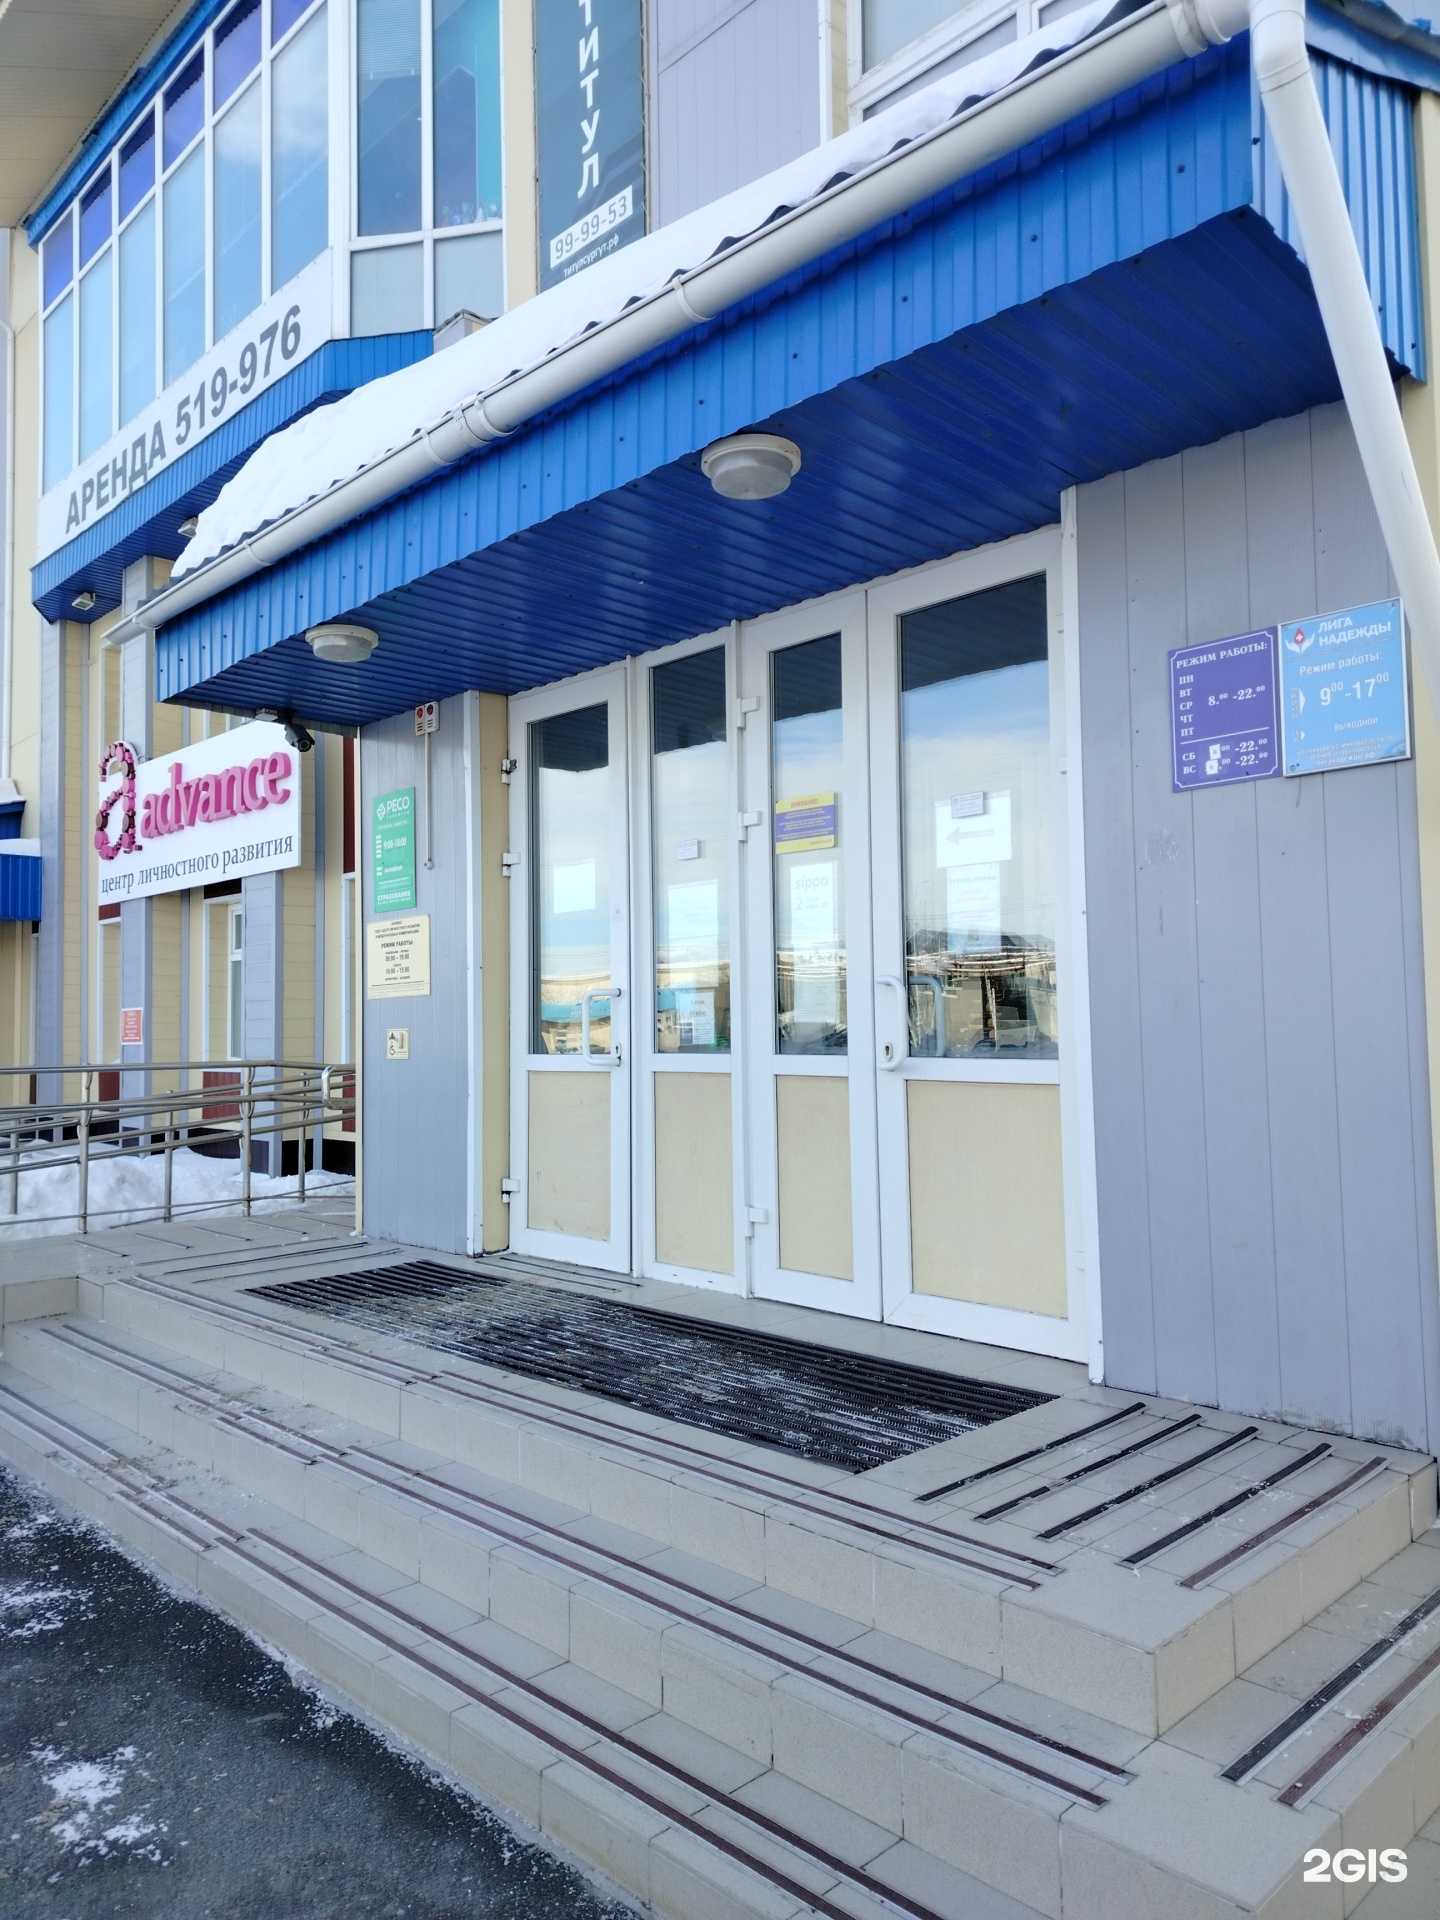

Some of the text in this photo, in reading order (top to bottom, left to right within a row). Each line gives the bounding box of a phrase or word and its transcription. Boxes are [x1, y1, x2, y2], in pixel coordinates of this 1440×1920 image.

[555, 195, 627, 259] 99-99-53
[65, 304, 301, 535] АРЕНДА 519-976
[1318, 616, 1353, 633] ЛИГА
[1318, 621, 1393, 646] НАДЕЖДЫ
[1176, 641, 1268, 669] РЕЖИМ РАБОТЫ:
[1299, 662, 1336, 676] Режим
[1179, 674, 1194, 685] ПН
[1179, 688, 1192, 698] ВТ
[1180, 701, 1193, 711] СР
[1180, 714, 1193, 724] ЧТ
[1181, 727, 1194, 737] ПТ
[1182, 751, 1196, 762] СБ
[1183, 765, 1197, 775] ВС
[141, 752, 293, 839] advance
[386, 796, 410, 812] РЕСО
[101, 835, 294, 894] центр личностного развития
